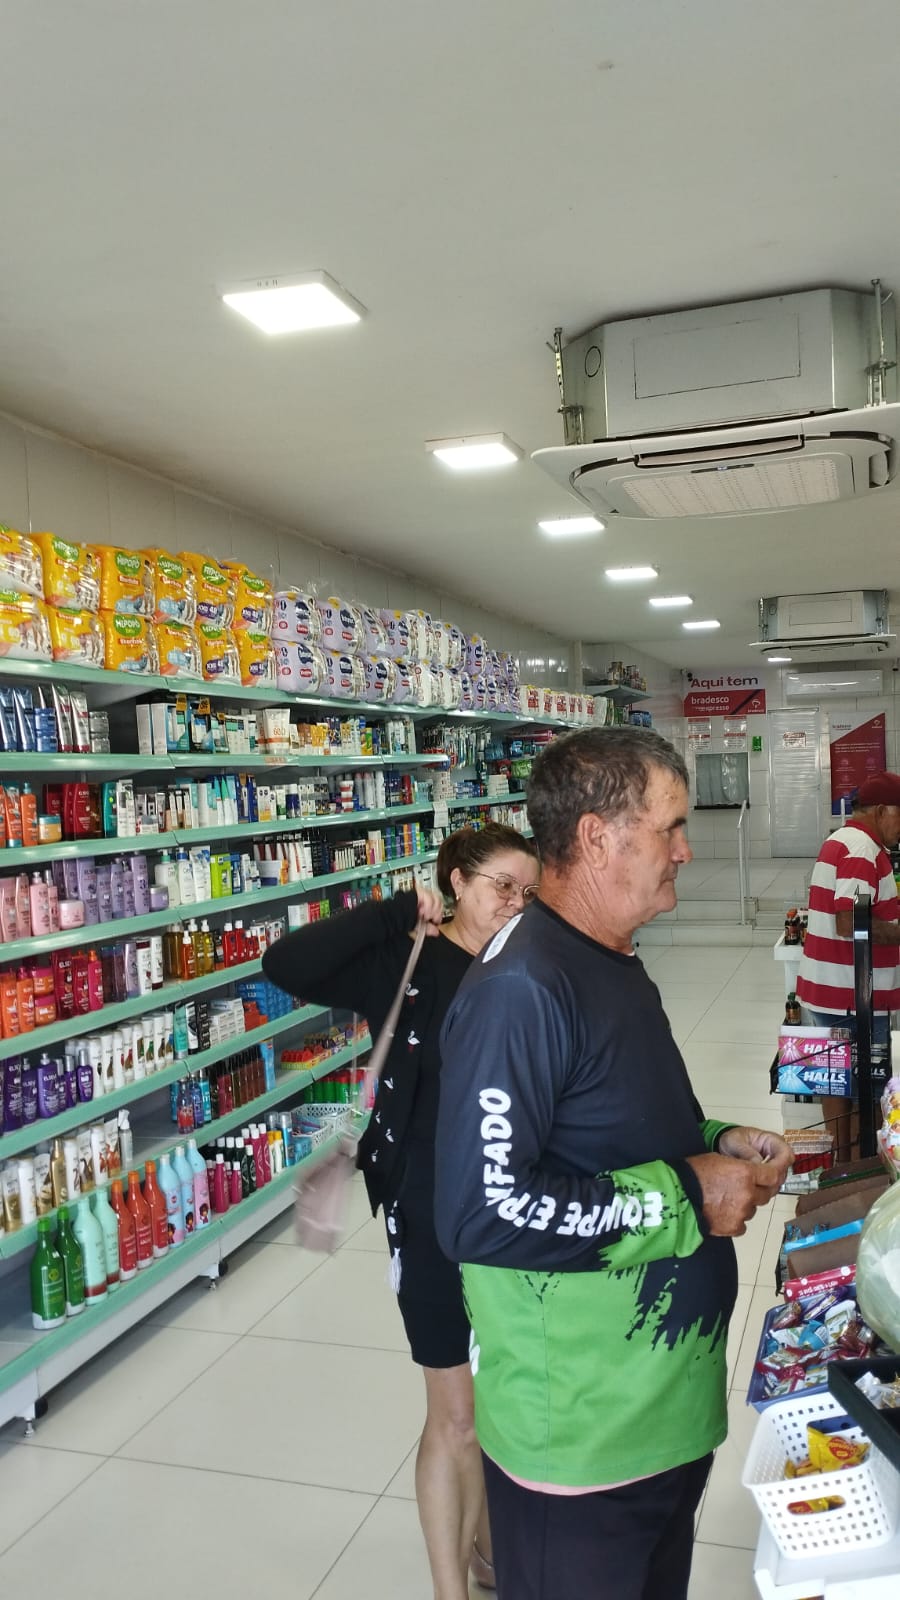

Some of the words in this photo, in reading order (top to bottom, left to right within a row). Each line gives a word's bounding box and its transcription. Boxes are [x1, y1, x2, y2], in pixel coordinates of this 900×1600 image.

[691, 677, 724, 689] Aqui
[727, 676, 759, 686] tem
[691, 695, 730, 705] bradesco
[803, 1043, 846, 1056] HALLS
[803, 1071, 846, 1083] HALLS
[556, 1190, 663, 1237] EQUIPE
